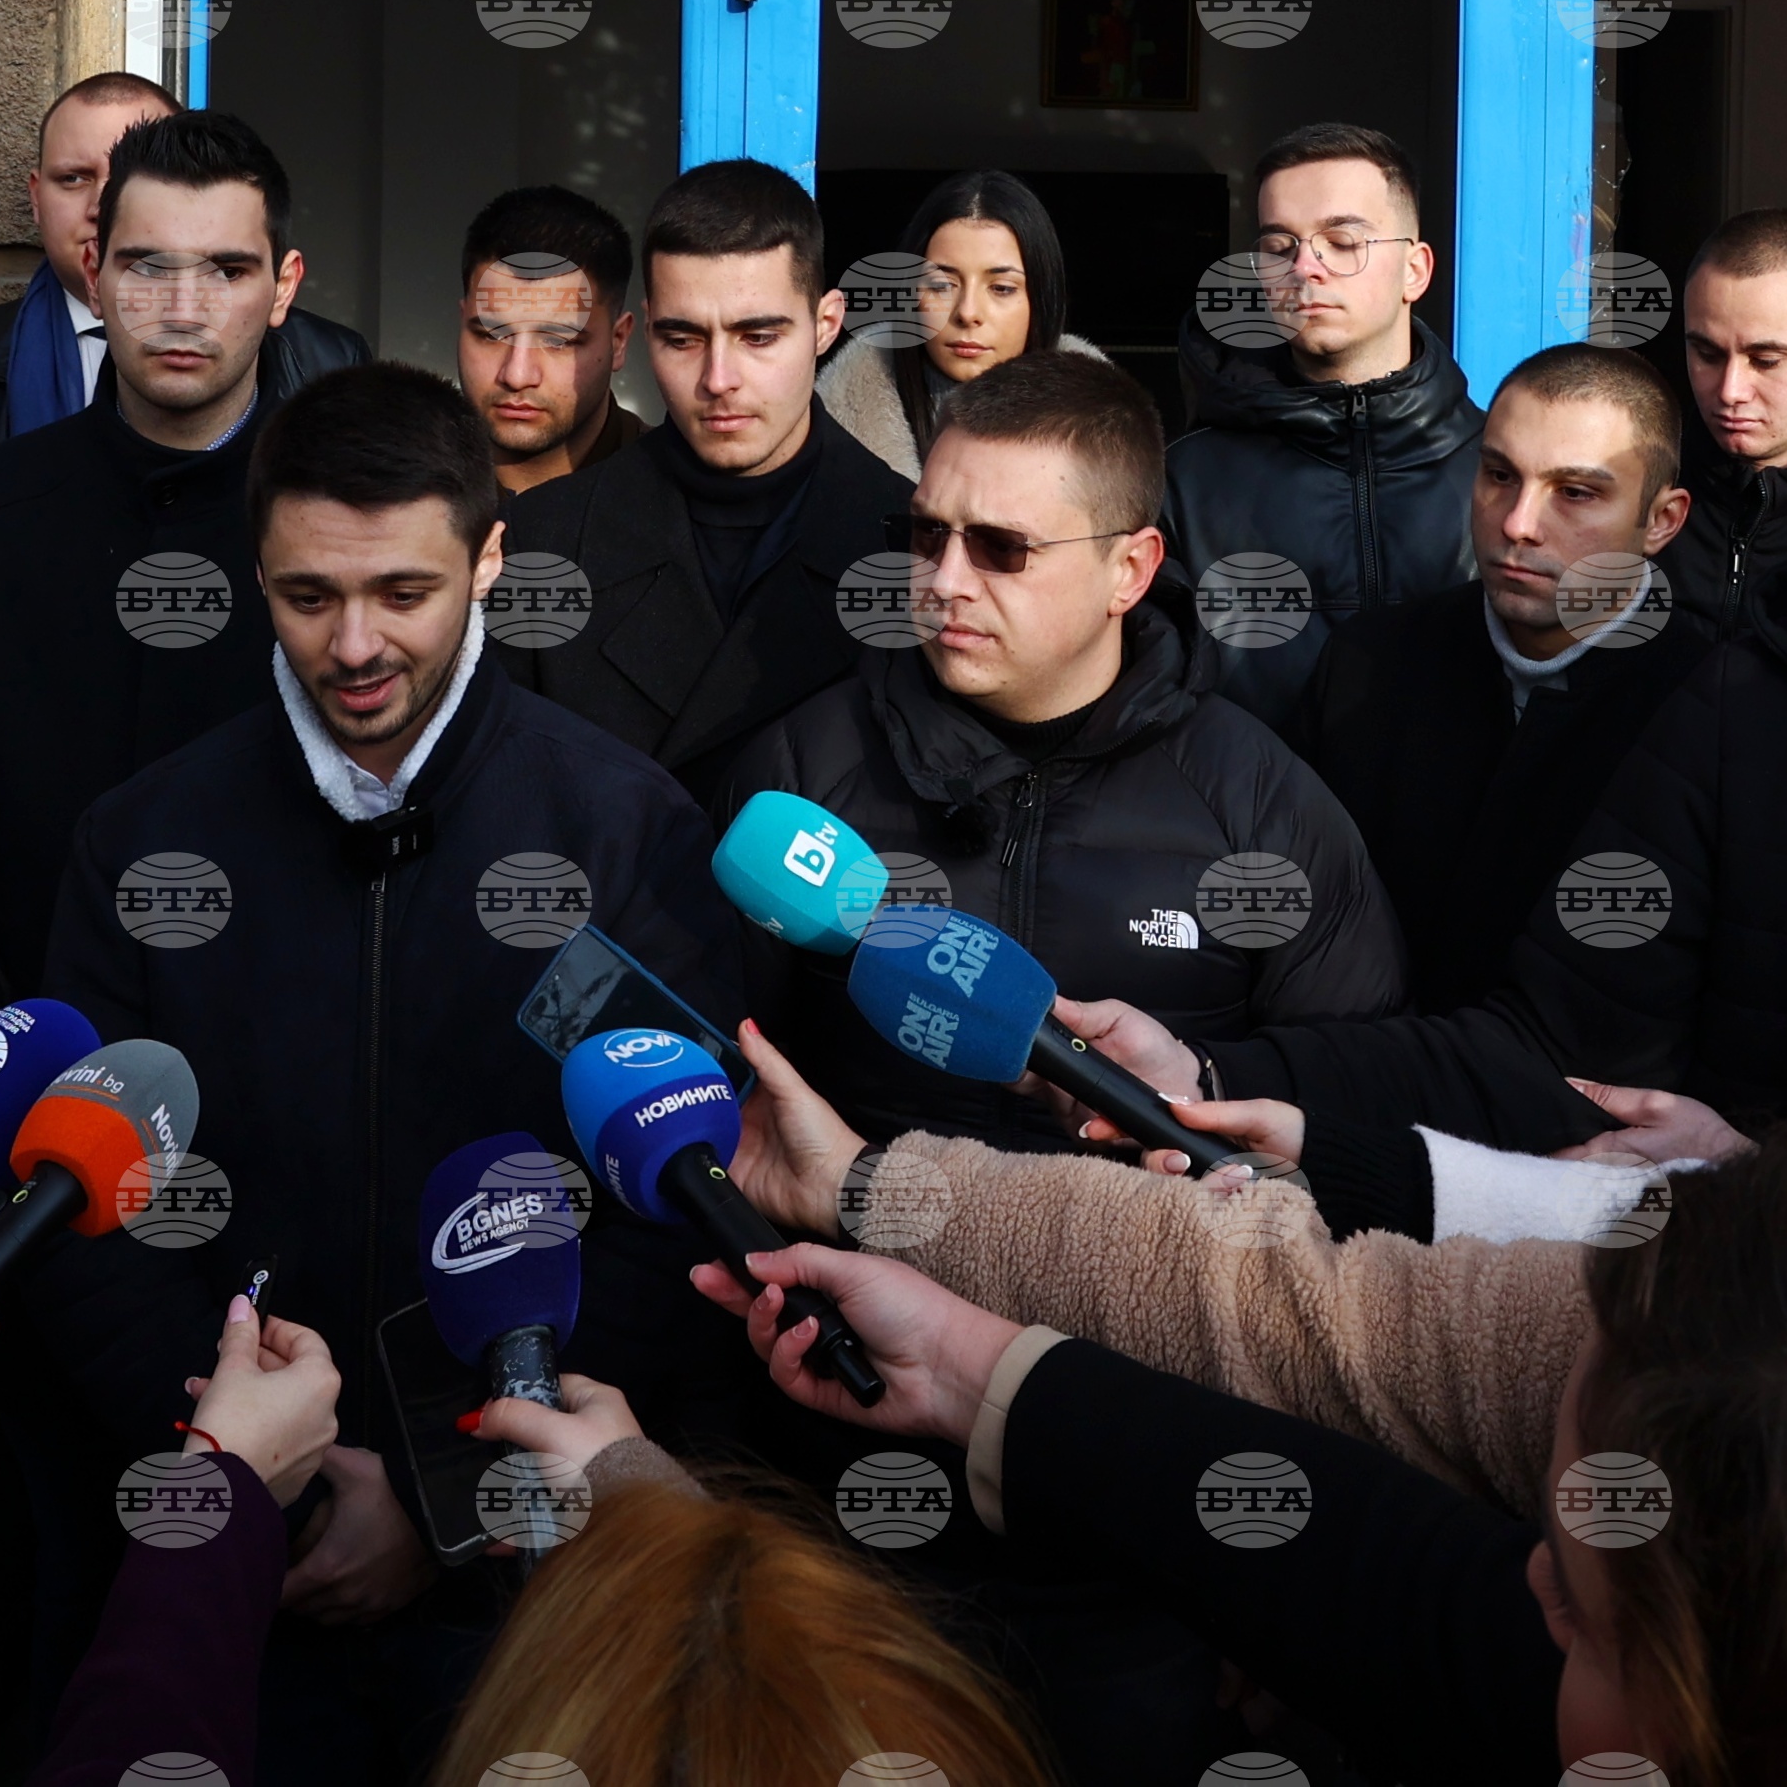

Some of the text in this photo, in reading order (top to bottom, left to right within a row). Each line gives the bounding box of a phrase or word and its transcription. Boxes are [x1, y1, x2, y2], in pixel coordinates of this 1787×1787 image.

[1129, 919, 1176, 934] NORTH
[1151, 909, 1178, 922] THE
[1142, 934, 1176, 947] FACE
[927, 921, 999, 998] ON AIR
[604, 1033, 682, 1063] NOVA
[898, 1000, 960, 1070] ON AIR
[50, 1065, 125, 1094] ovini.bg
[634, 1084, 732, 1128] НОВИНИТЕ
[455, 1193, 544, 1243] BGNES
[460, 1217, 530, 1254] NEWS AGENCY
